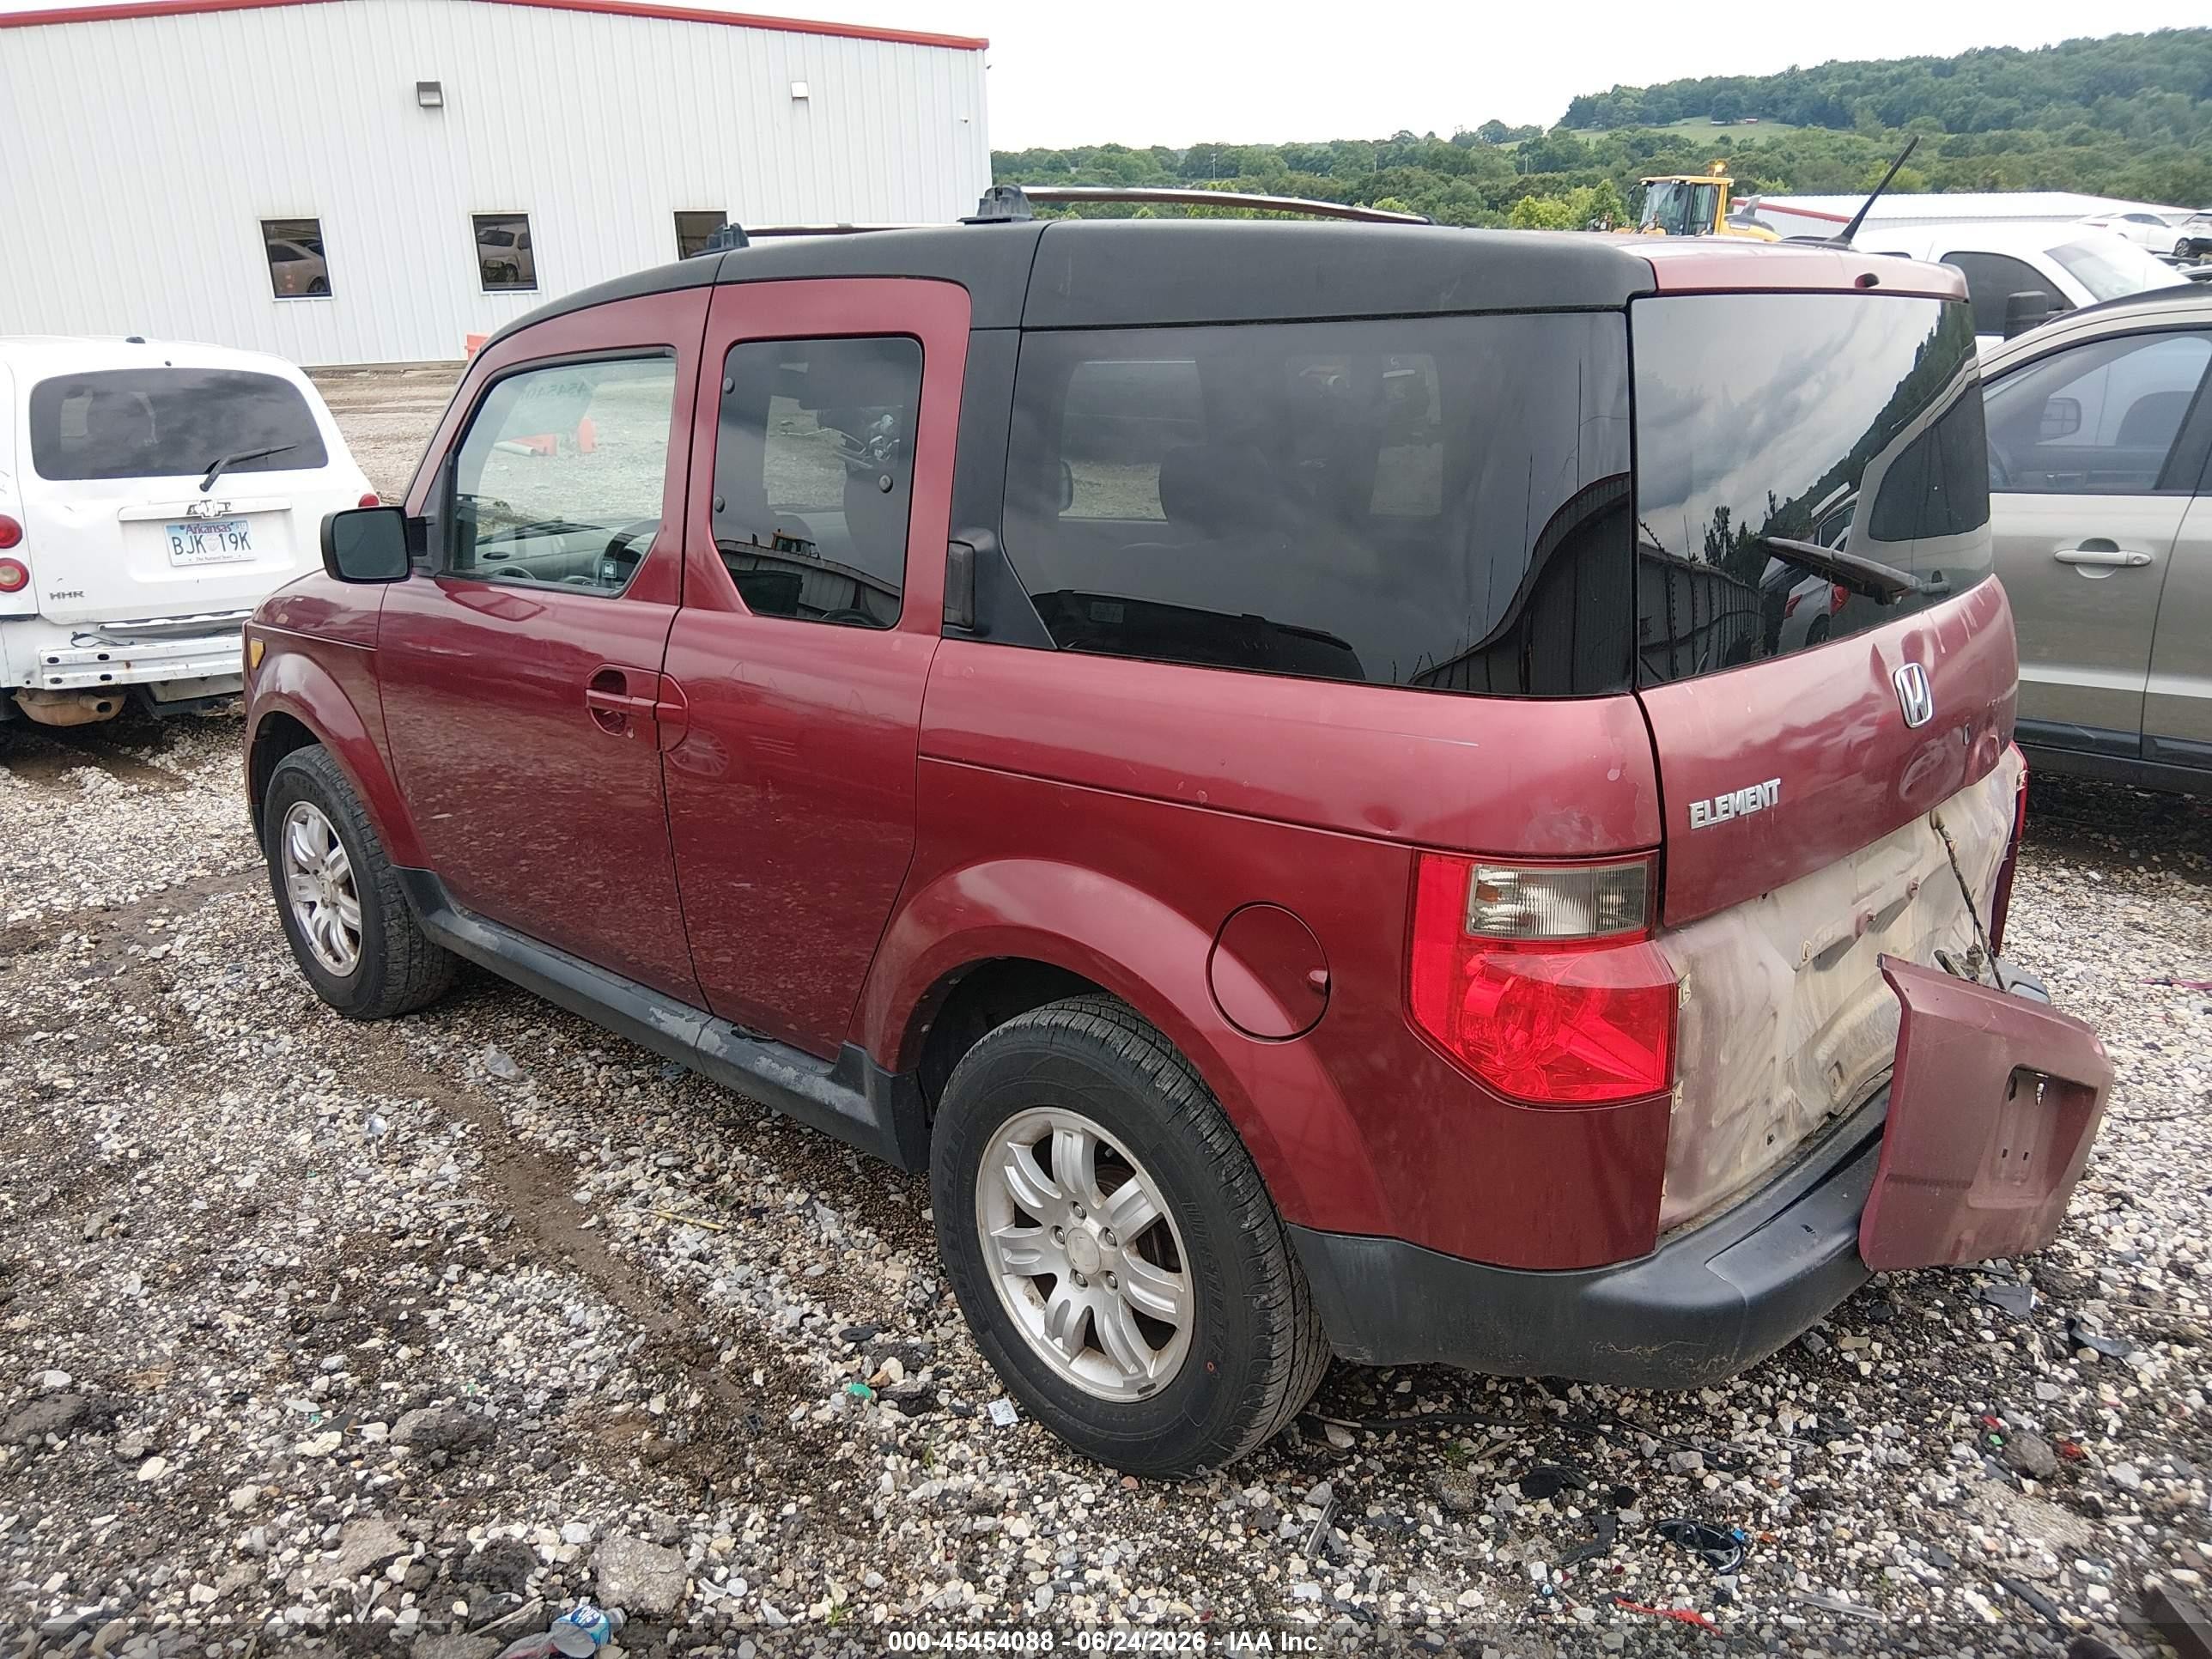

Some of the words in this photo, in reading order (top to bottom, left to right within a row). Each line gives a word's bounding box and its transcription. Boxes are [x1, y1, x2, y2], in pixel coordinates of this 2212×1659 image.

[185, 523, 233, 535] Arkansas
[171, 535, 207, 556] BJK
[218, 532, 252, 552] 19K
[49, 590, 85, 601] HHR
[1688, 778, 1782, 830] ELEMENT
